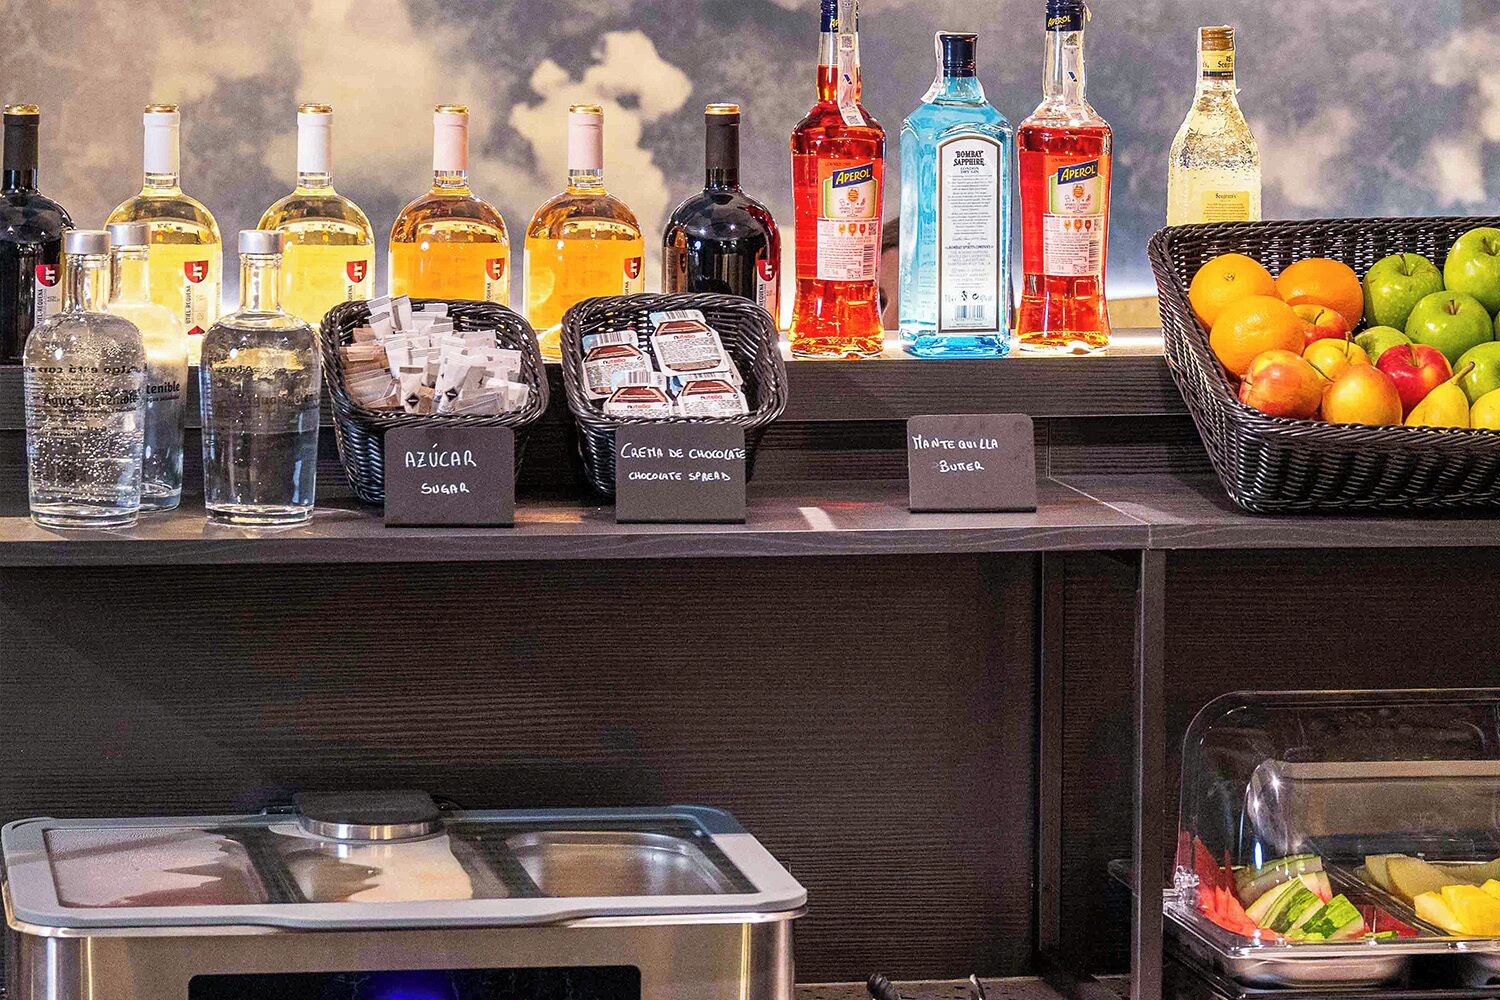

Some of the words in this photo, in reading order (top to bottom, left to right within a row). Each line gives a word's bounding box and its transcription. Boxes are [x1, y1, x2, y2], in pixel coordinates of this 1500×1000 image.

[955, 150, 984, 158] BOMBAY
[953, 158, 985, 166] SAPPHIRE
[835, 168, 871, 185] APEROL
[1060, 165, 1096, 182] APEROL
[405, 443, 477, 468] AZÚCAR
[620, 442, 663, 458] CREMA
[668, 448, 683, 458] DE
[689, 447, 746, 460] CHOCOLATE
[939, 460, 984, 473] BUTTER
[628, 471, 682, 481] CHOCOLATE
[688, 471, 731, 481] SPREAD
[420, 482, 470, 495] SUGAR
